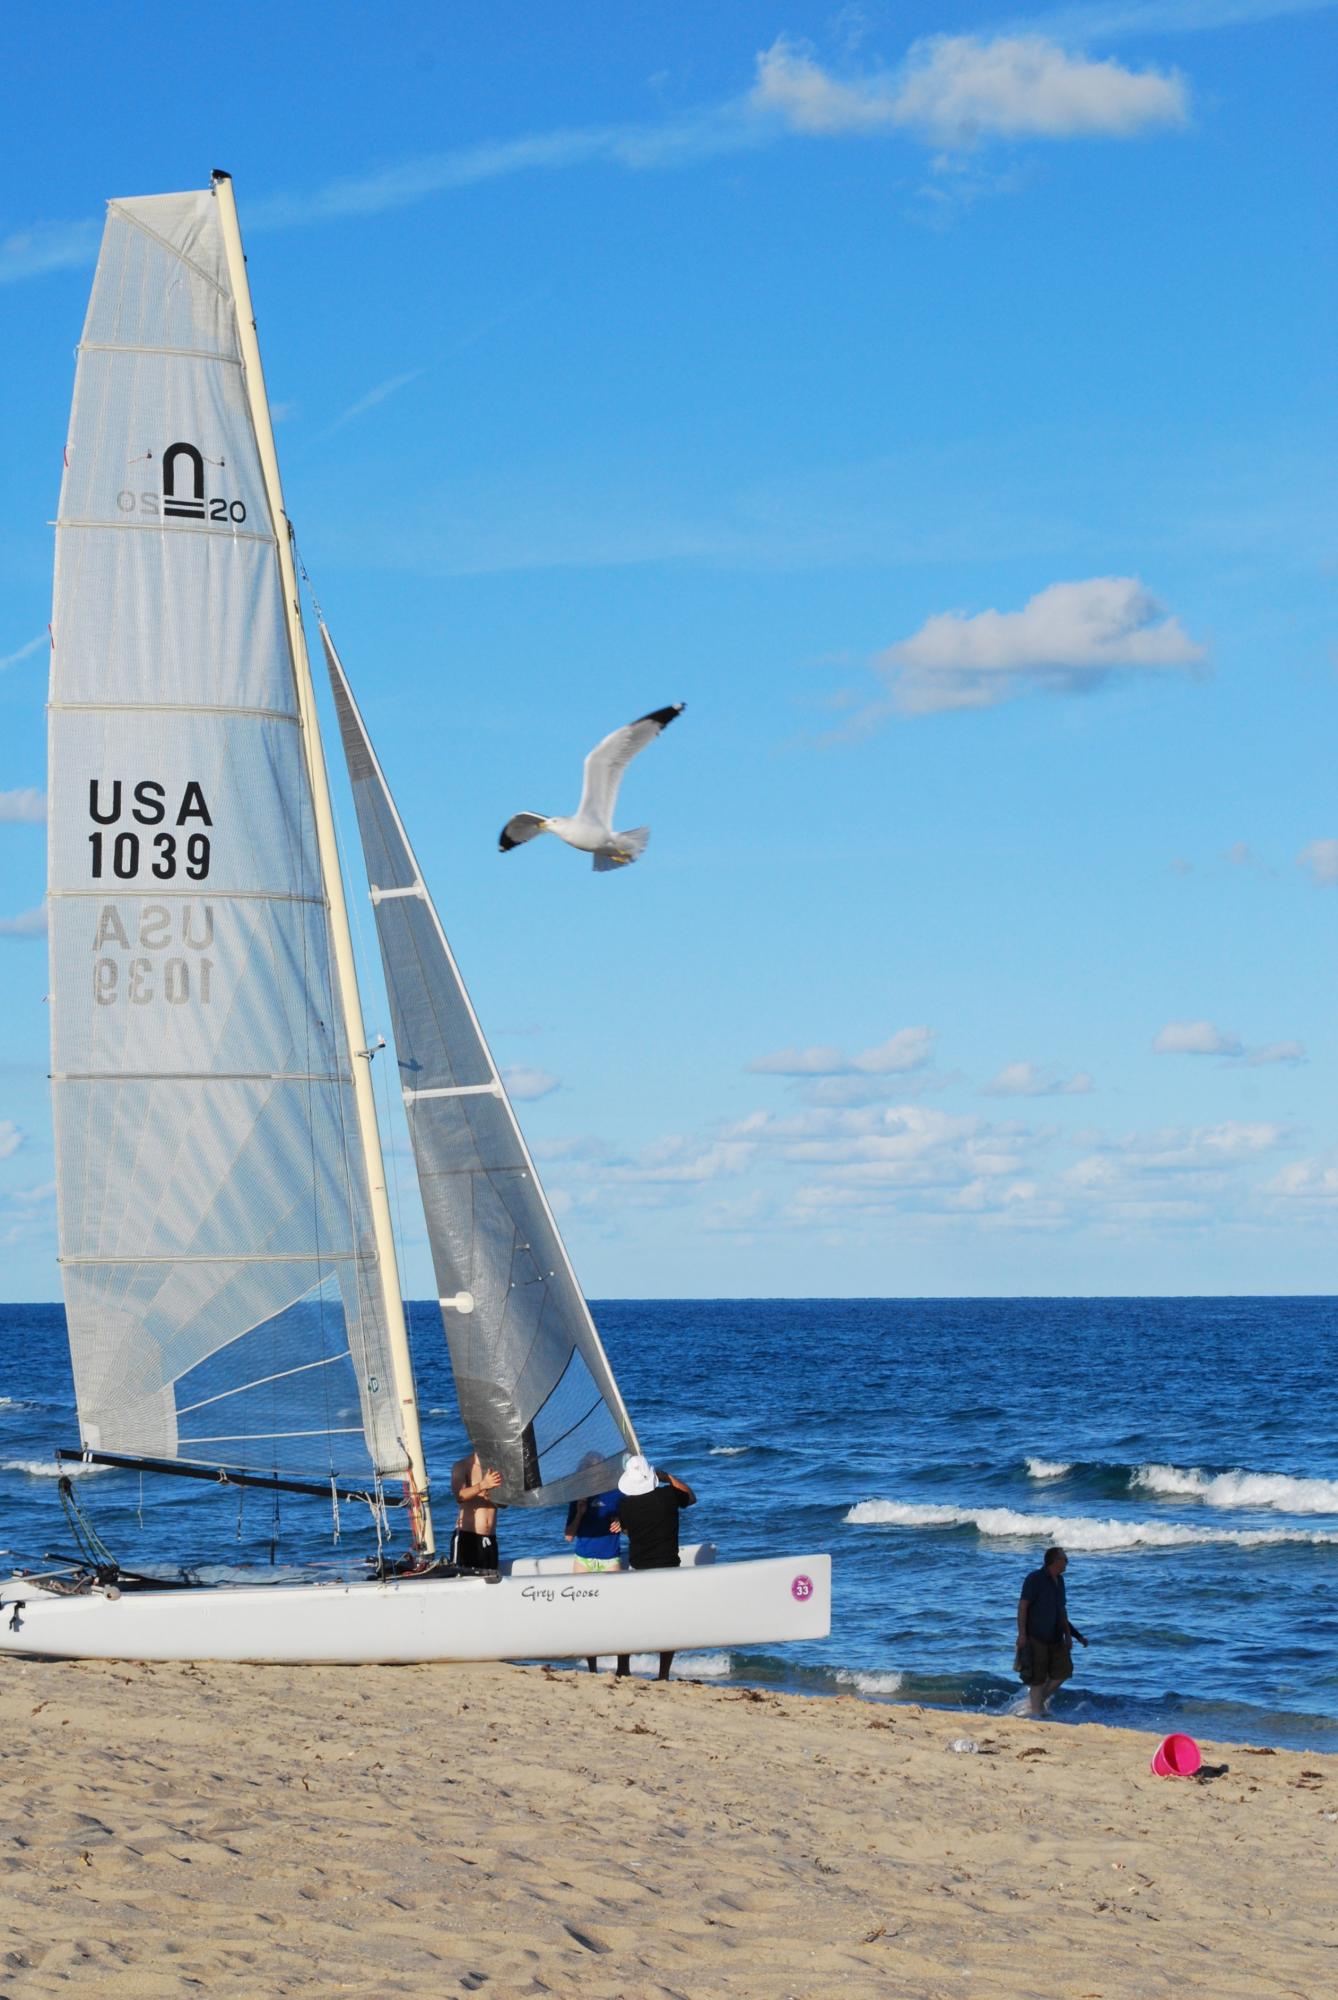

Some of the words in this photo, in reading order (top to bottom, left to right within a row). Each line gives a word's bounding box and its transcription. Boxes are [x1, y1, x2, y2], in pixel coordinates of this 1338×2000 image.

[209, 498, 247, 523] 20
[89, 779, 213, 827] USA
[88, 831, 211, 881] 1039
[521, 1586, 554, 1602] Grey
[561, 1586, 600, 1602] Goose
[796, 1585, 809, 1596] 33
